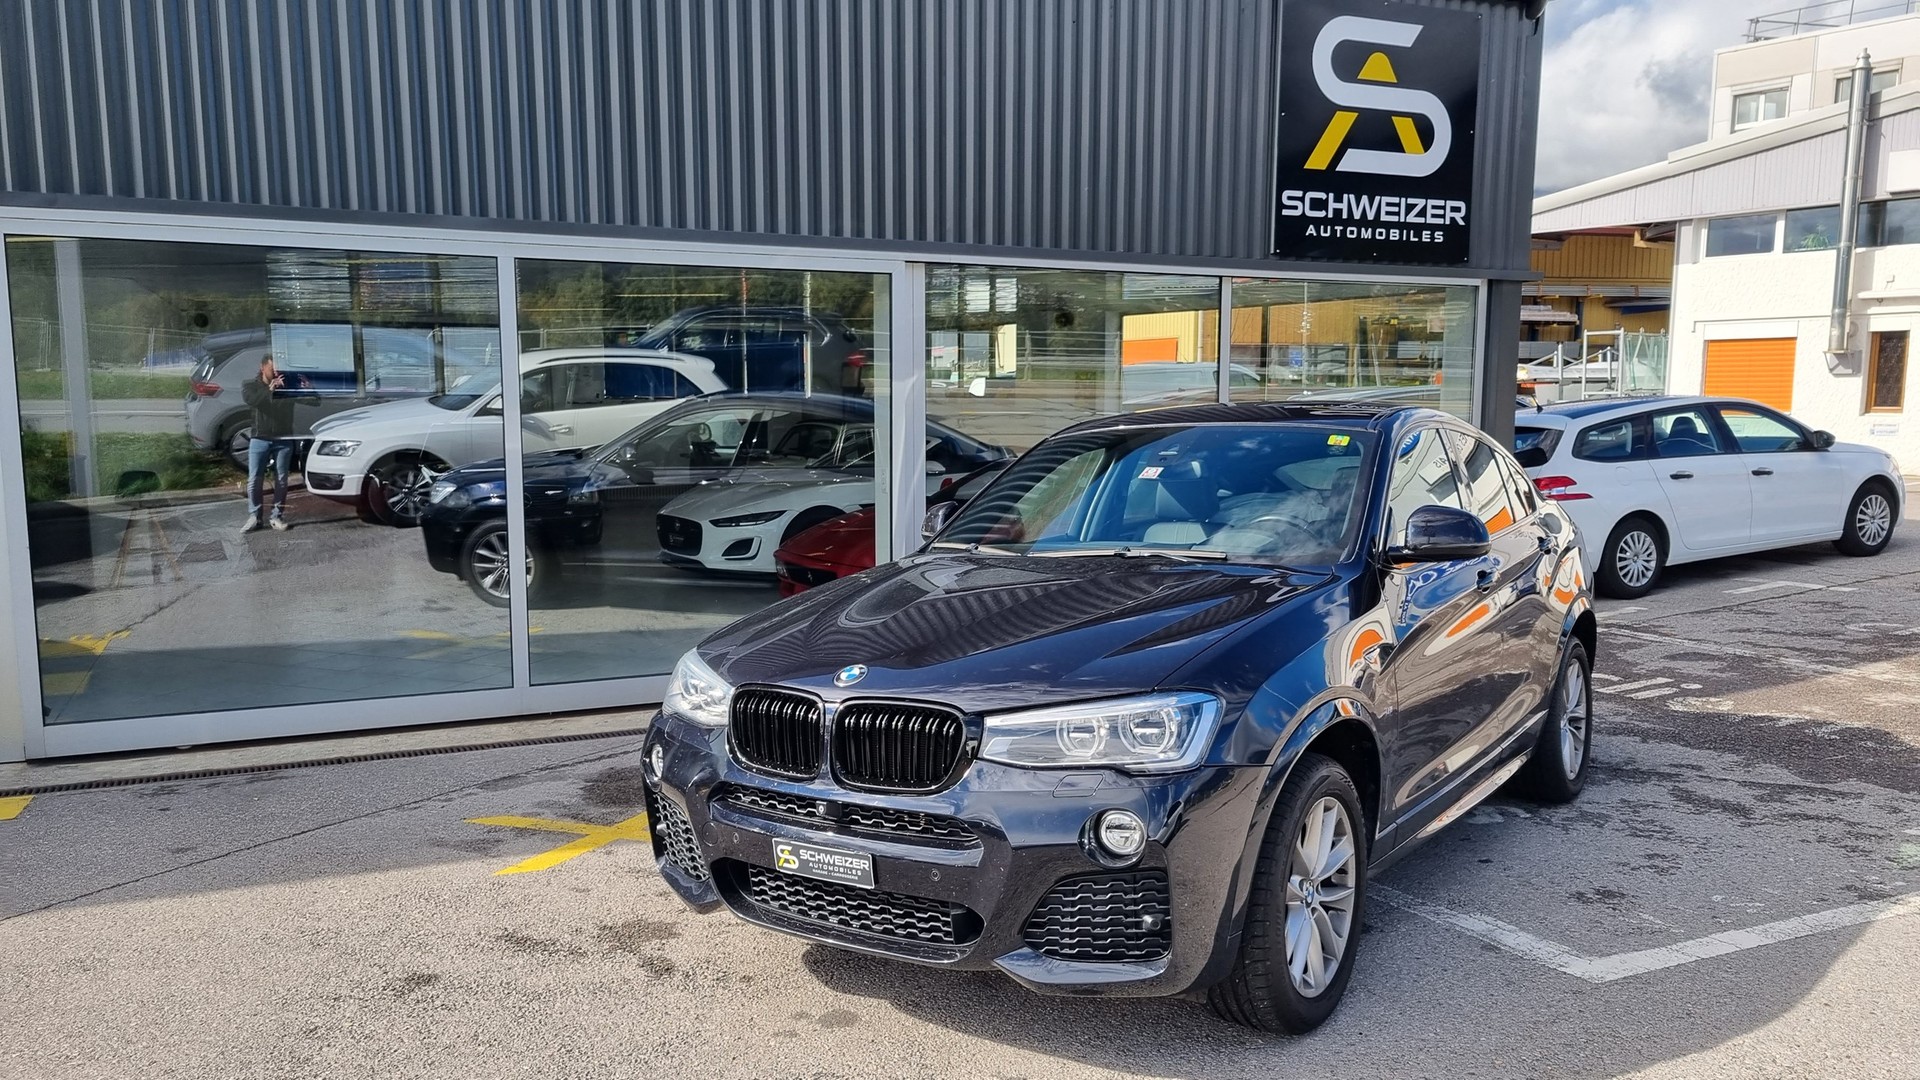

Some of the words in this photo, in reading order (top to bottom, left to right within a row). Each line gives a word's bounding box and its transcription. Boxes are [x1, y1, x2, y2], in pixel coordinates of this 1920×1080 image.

[1281, 189, 1466, 226] SCHWEIZER
[1305, 224, 1444, 243] AUTOMOBILES
[799, 849, 870, 871] SCHWEIZER
[808, 862, 862, 876] AUTOMOBILES
